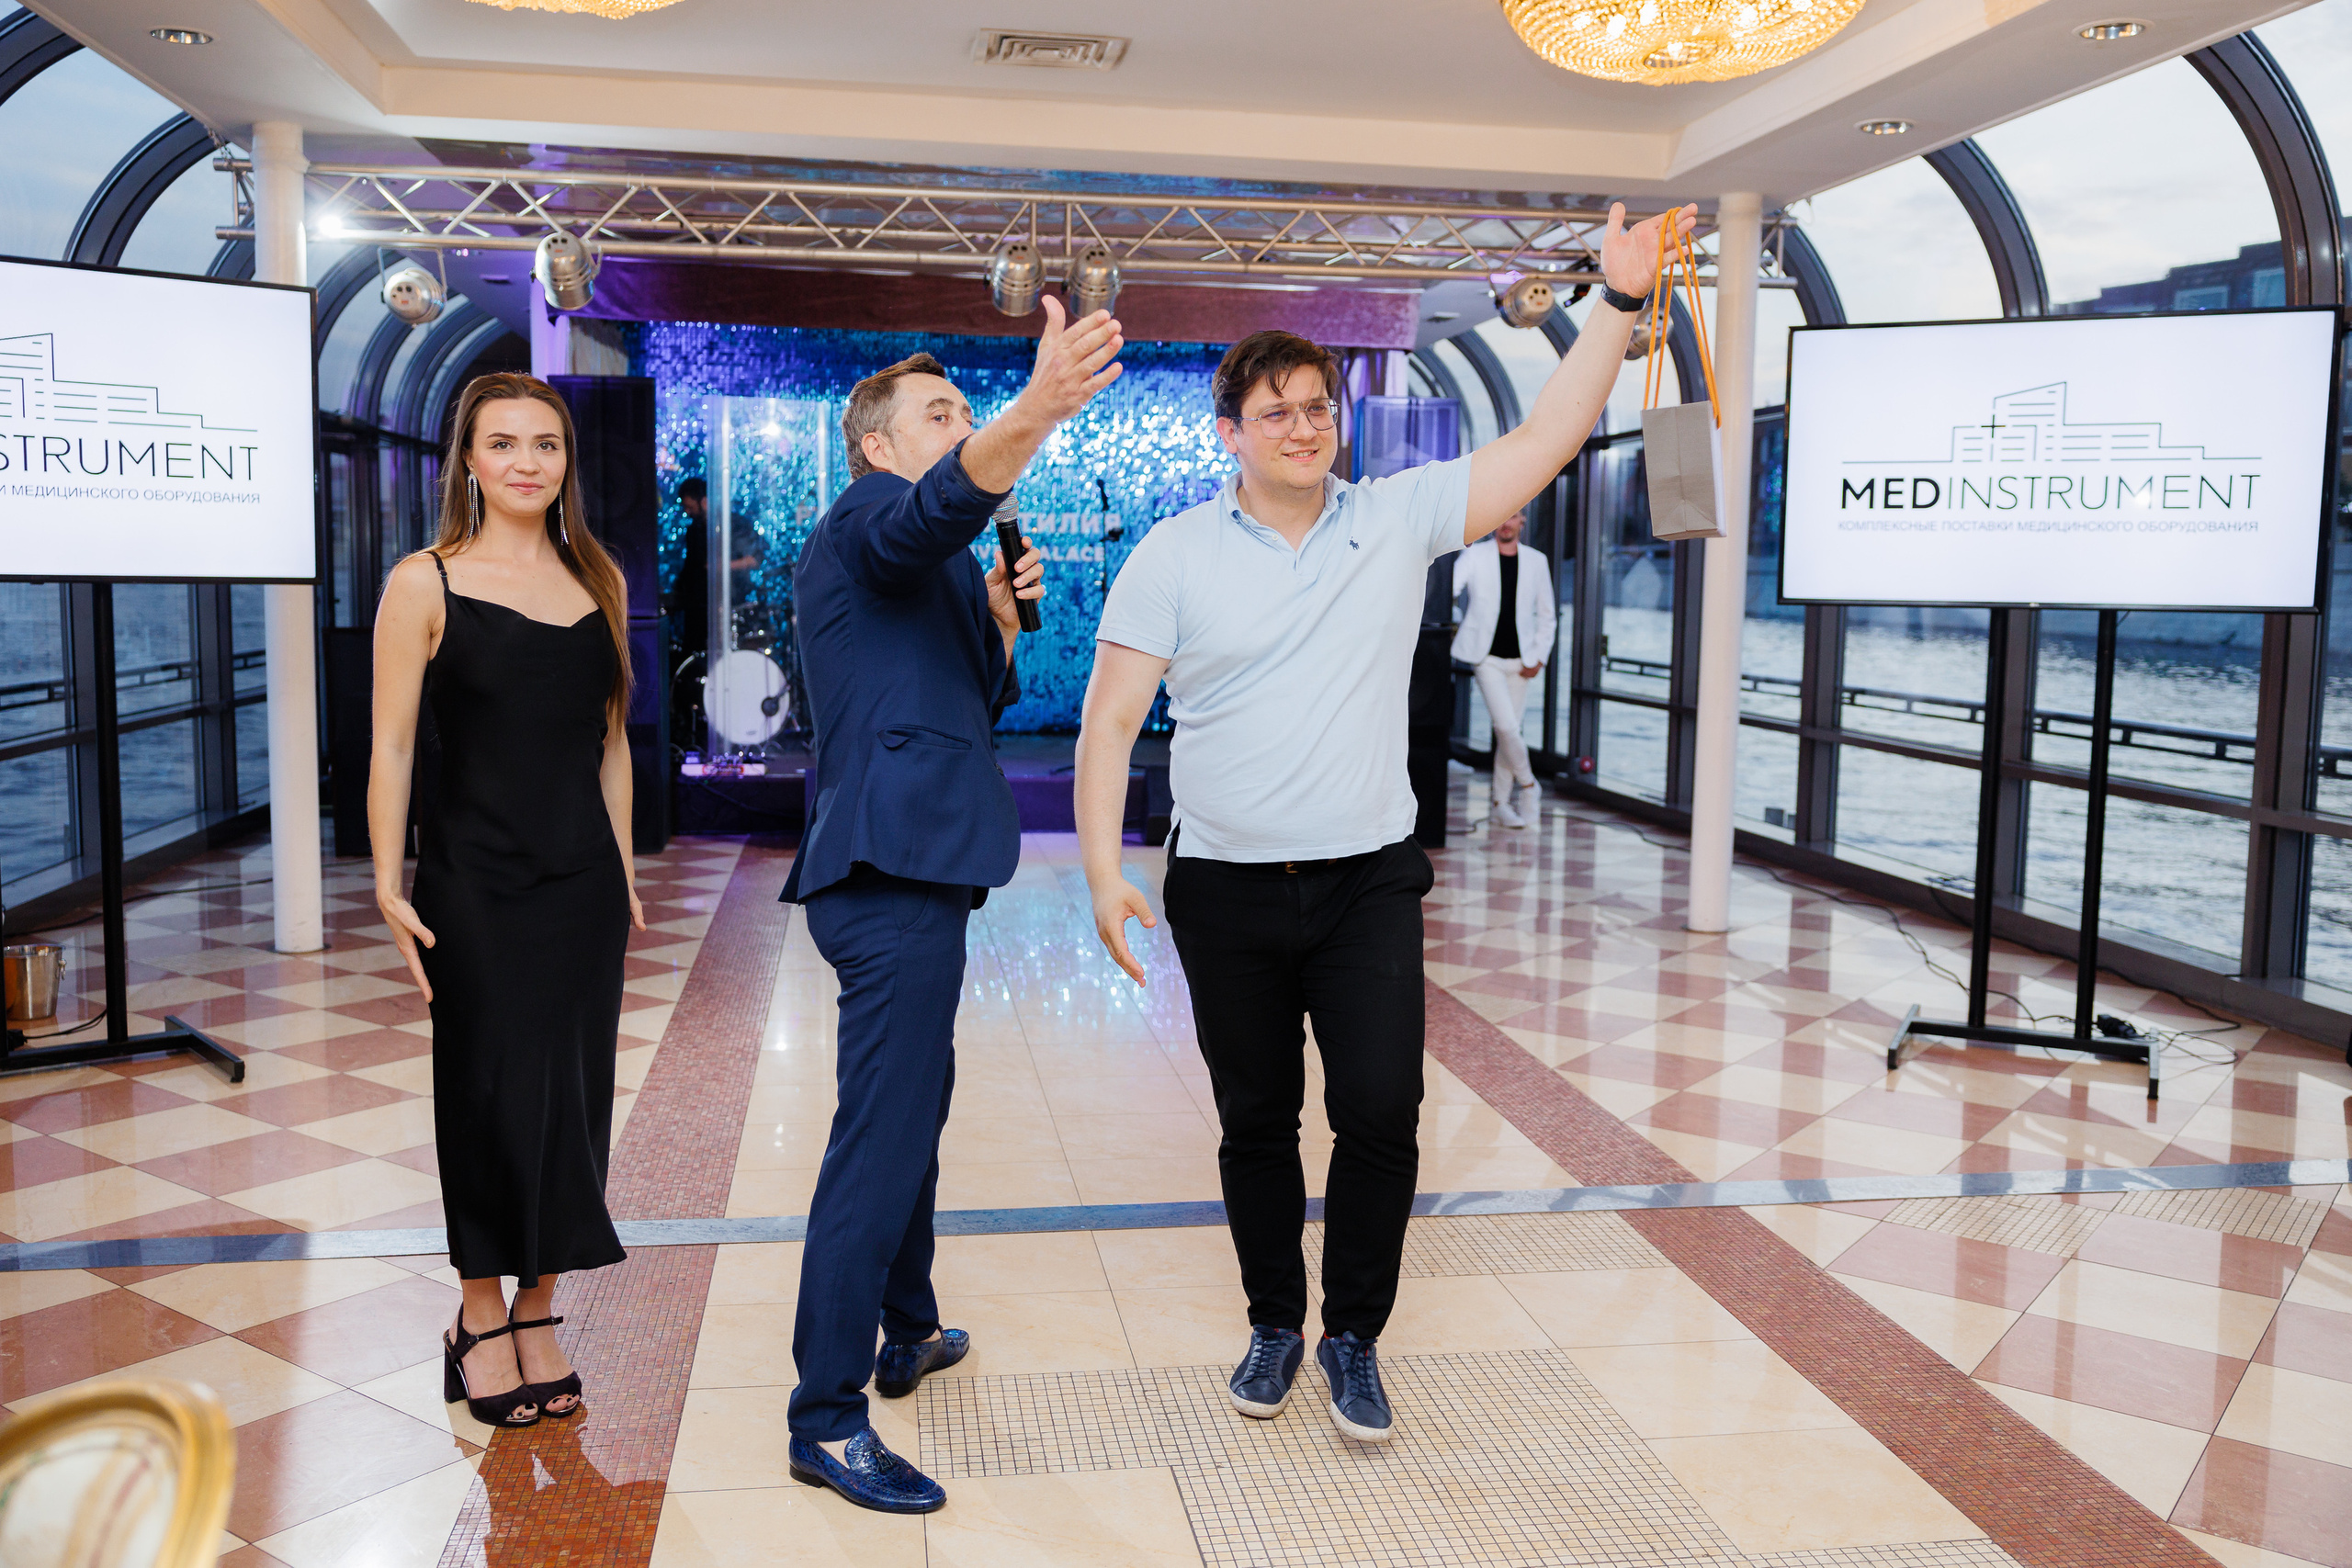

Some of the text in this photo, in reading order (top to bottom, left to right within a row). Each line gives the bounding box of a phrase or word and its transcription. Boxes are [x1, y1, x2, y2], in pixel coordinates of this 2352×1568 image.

[12, 485, 139, 501] МЕДИЦИНСКОГО
[143, 489, 261, 503] ОБОРУДОВАНИЯ
[1841, 475, 2261, 510] MEDINSTRUMENT
[1838, 519, 2258, 533] КОМПЛЕКСНЫЕ ПОСТАВКИ МЕДИЦИНСКОГО ОБОРУДОВАНИЯ
[1030, 546, 1105, 562] ALACE
